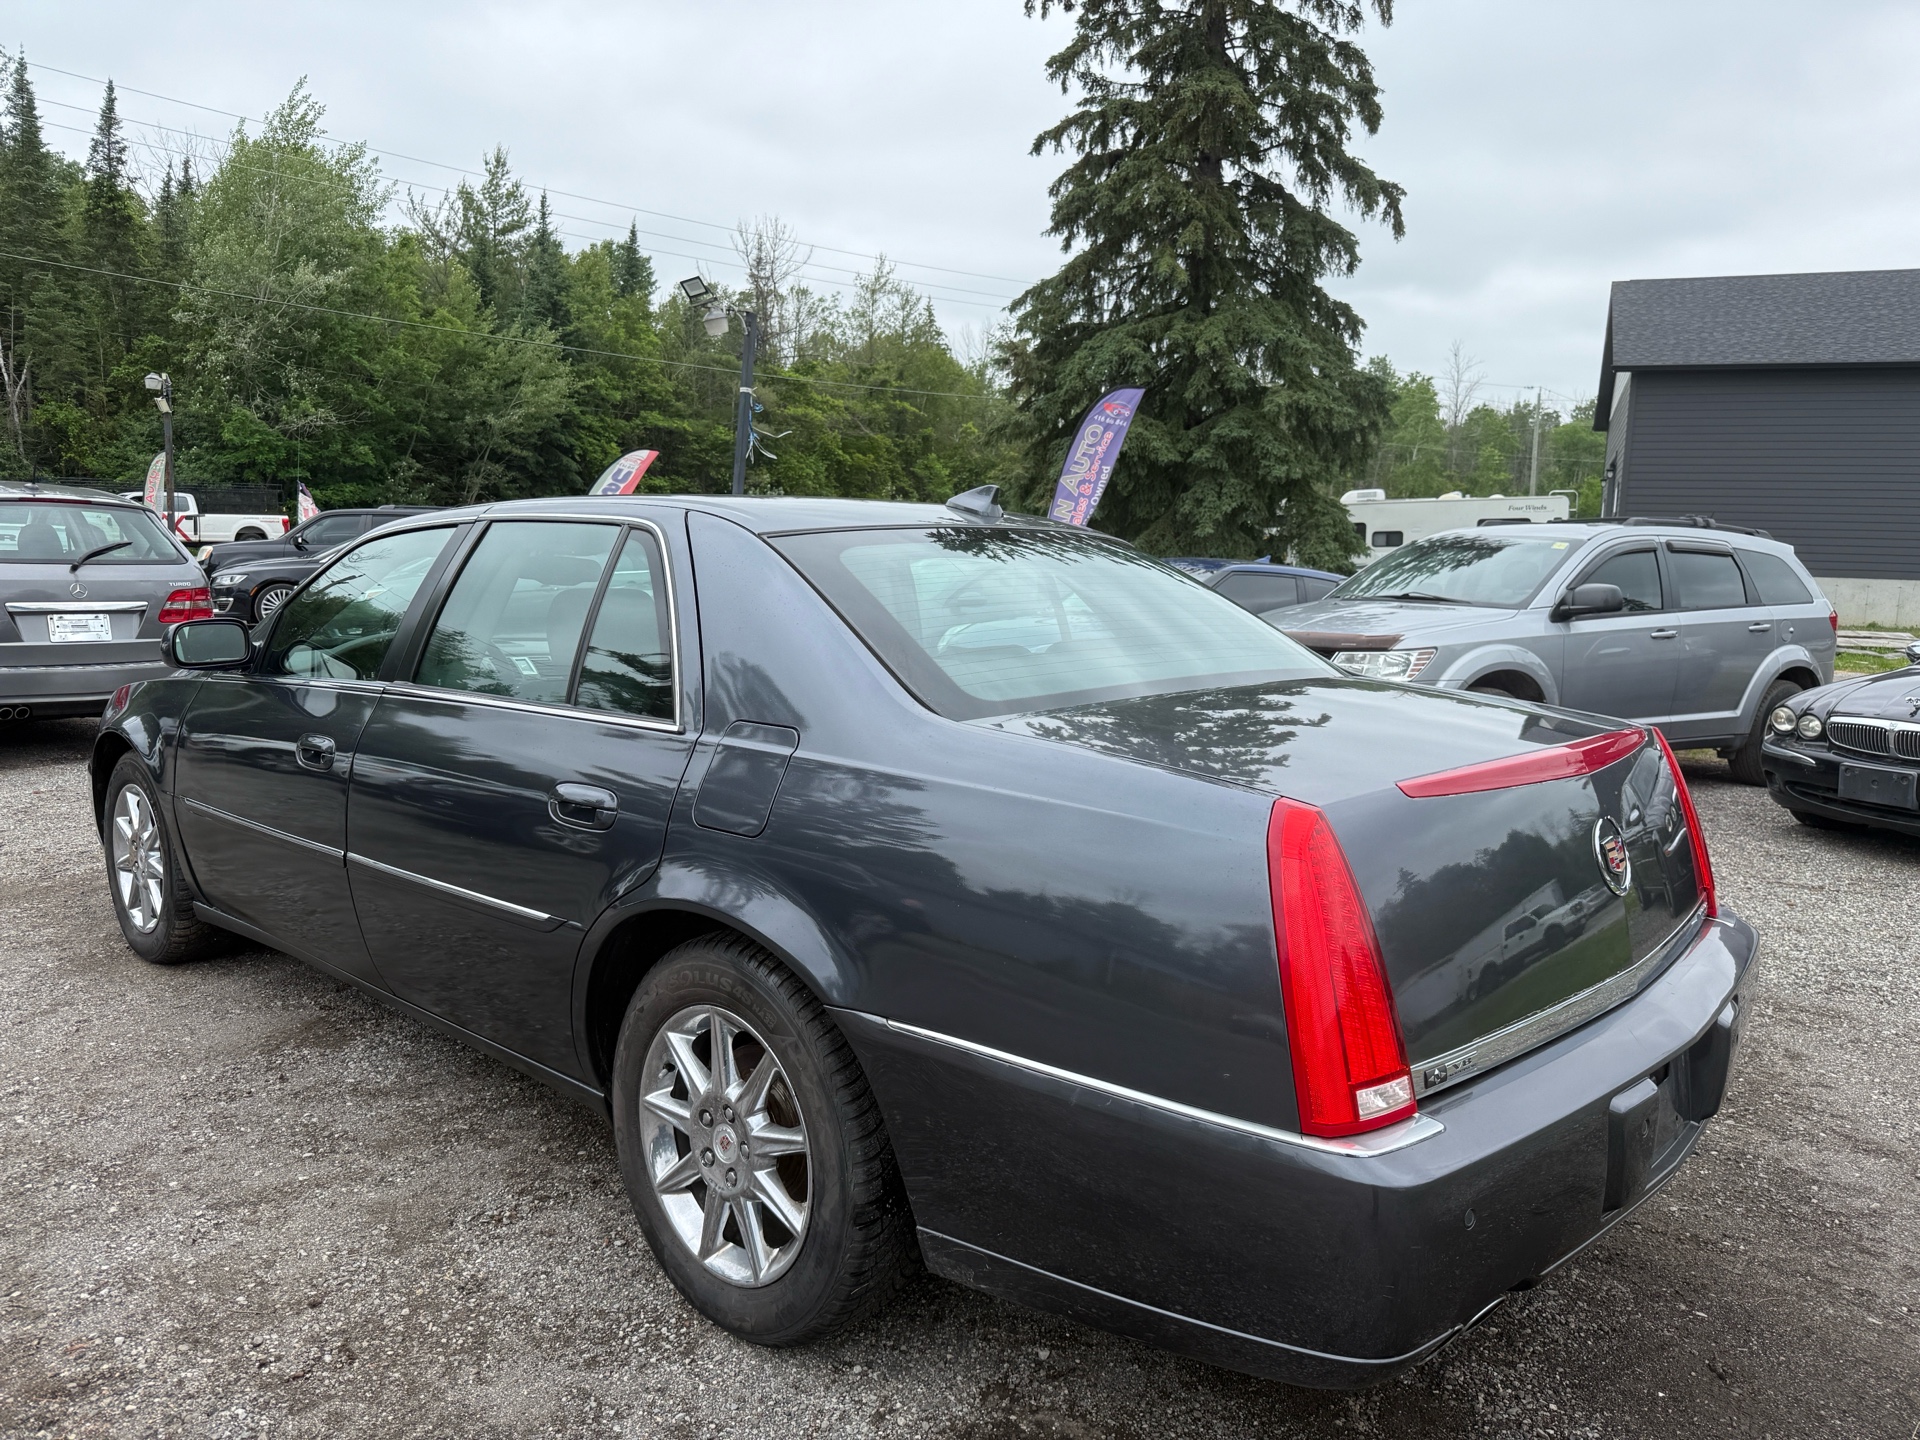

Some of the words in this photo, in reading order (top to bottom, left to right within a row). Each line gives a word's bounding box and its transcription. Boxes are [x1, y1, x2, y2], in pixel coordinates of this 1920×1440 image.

[1060, 424, 1104, 496] AUTO
[1072, 497, 1088, 525] ales
[1085, 431, 1114, 481] Service
[1091, 466, 1111, 506] Owned
[1054, 499, 1075, 523] N
[667, 970, 732, 992] SOLUS
